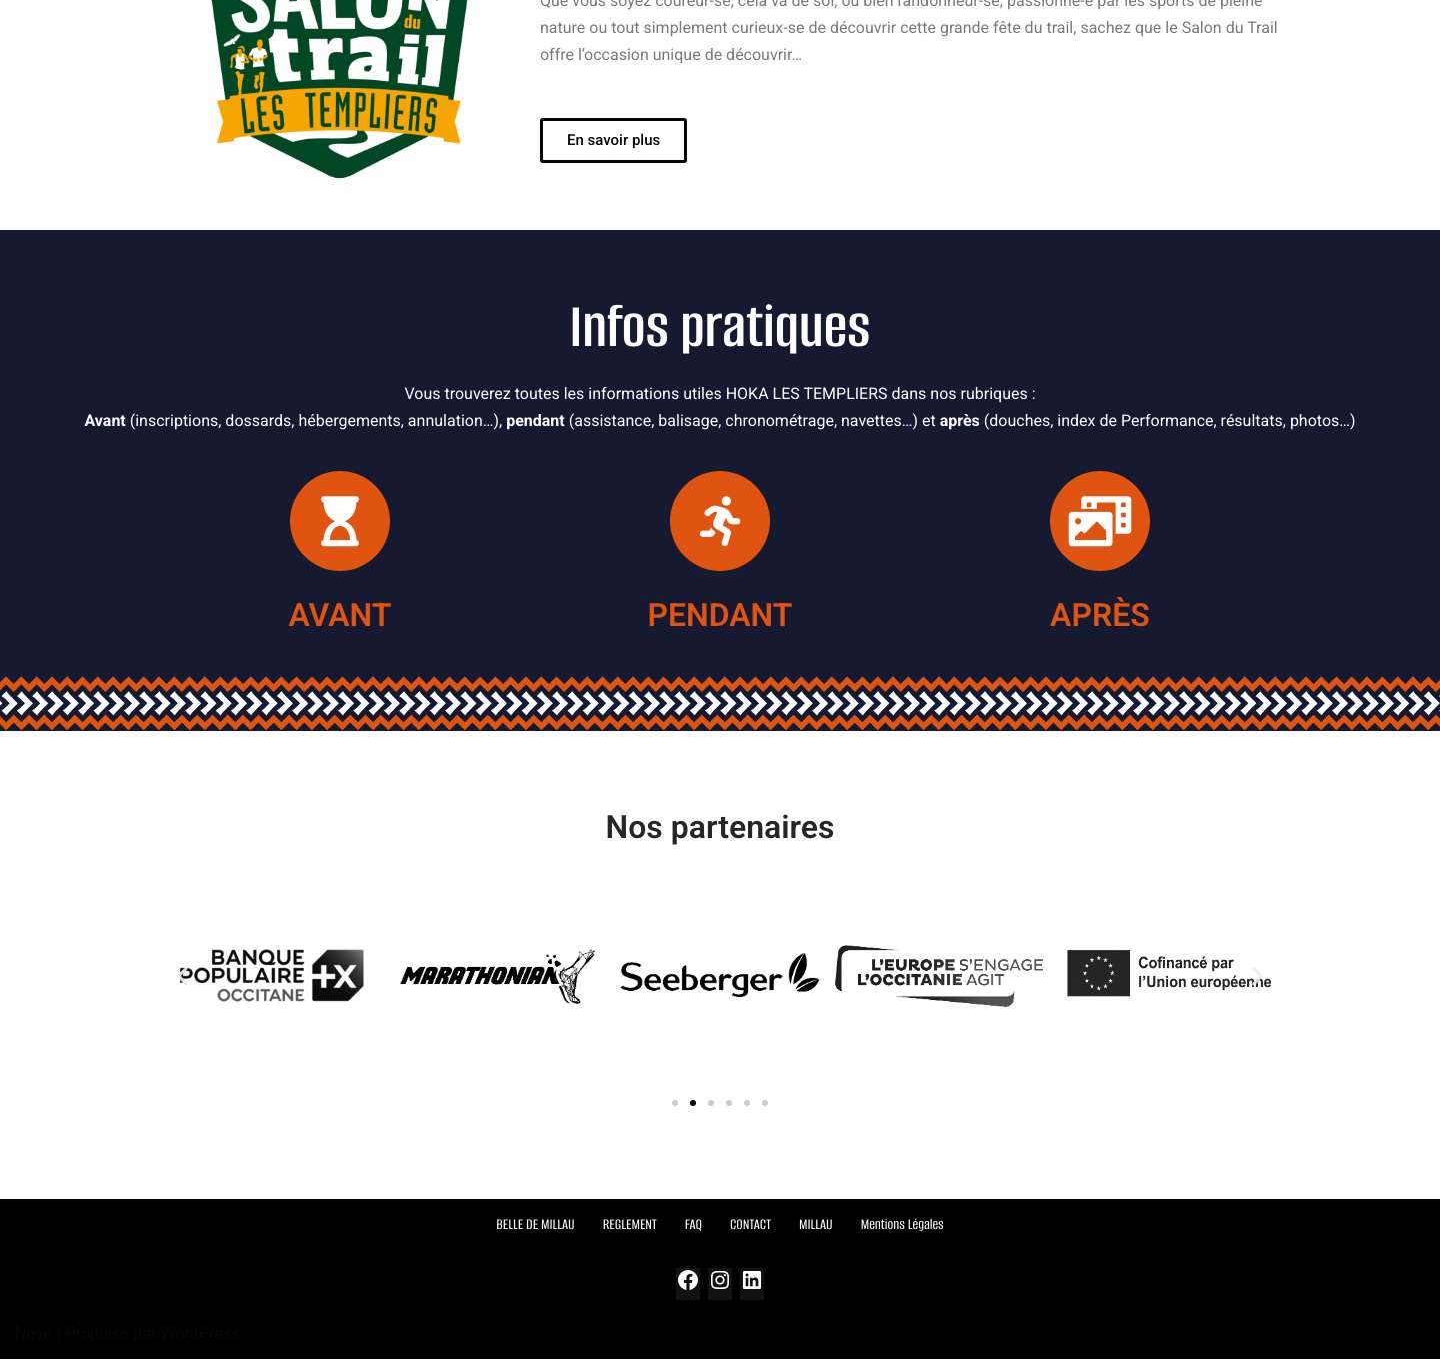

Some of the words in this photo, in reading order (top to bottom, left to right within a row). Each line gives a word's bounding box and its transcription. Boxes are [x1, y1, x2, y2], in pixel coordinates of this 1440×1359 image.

[403, 14, 421, 30] du
[268, 29, 446, 87] trail
[540, 47, 574, 61] offre
[653, 48, 701, 64] unique
[705, 47, 723, 61] de
[240, 94, 285, 134] LES
[305, 91, 438, 133] TEMPLIERS
[567, 133, 584, 146] En
[587, 133, 629, 146] savoir
[632, 132, 661, 149] plus
[571, 304, 668, 348] Infos
[682, 303, 870, 355] pratiques
[404, 386, 441, 400] Vous
[443, 387, 511, 400] trouverez
[514, 387, 560, 400] toutes
[564, 386, 585, 400] les
[588, 386, 680, 400] informations
[683, 386, 722, 400] utiles
[726, 386, 770, 400] HOKA
[773, 386, 800, 400] LES
[803, 386, 888, 400] TEMPLIERS
[891, 386, 927, 400] dans
[930, 389, 957, 400] nos
[960, 386, 1028, 404] rubriques
[84, 413, 127, 427] Avant
[506, 413, 566, 430] pendant
[939, 413, 980, 431] après
[288, 602, 392, 627] AVANT
[648, 601, 793, 627] PENDANT
[1049, 595, 1150, 627] APRÈS
[606, 814, 663, 839] Nos
[671, 813, 834, 846] partenaires
[211, 949, 305, 965] BANQUE
[1138, 955, 1208, 970] Cofinancé
[1211, 958, 1235, 973] par
[179, 967, 305, 984] POPULAIRE
[400, 966, 560, 985] MARATHONIAN
[620, 962, 783, 998] Seeberger
[965, 973, 1005, 987] AGIT
[1190, 974, 1272, 991] européenne
[217, 988, 305, 1002] OCCITANE
[496, 1218, 524, 1230] BELLE
[526, 1218, 539, 1230] DE
[541, 1218, 575, 1230] MILLAU
[602, 1218, 657, 1230] REGLEMENT
[684, 1218, 703, 1232] FAQ
[729, 1218, 772, 1230] CONTACT
[799, 1218, 833, 1231] MILLAU
[860, 1218, 906, 1230] Mentions
[907, 1218, 944, 1232] Légales
